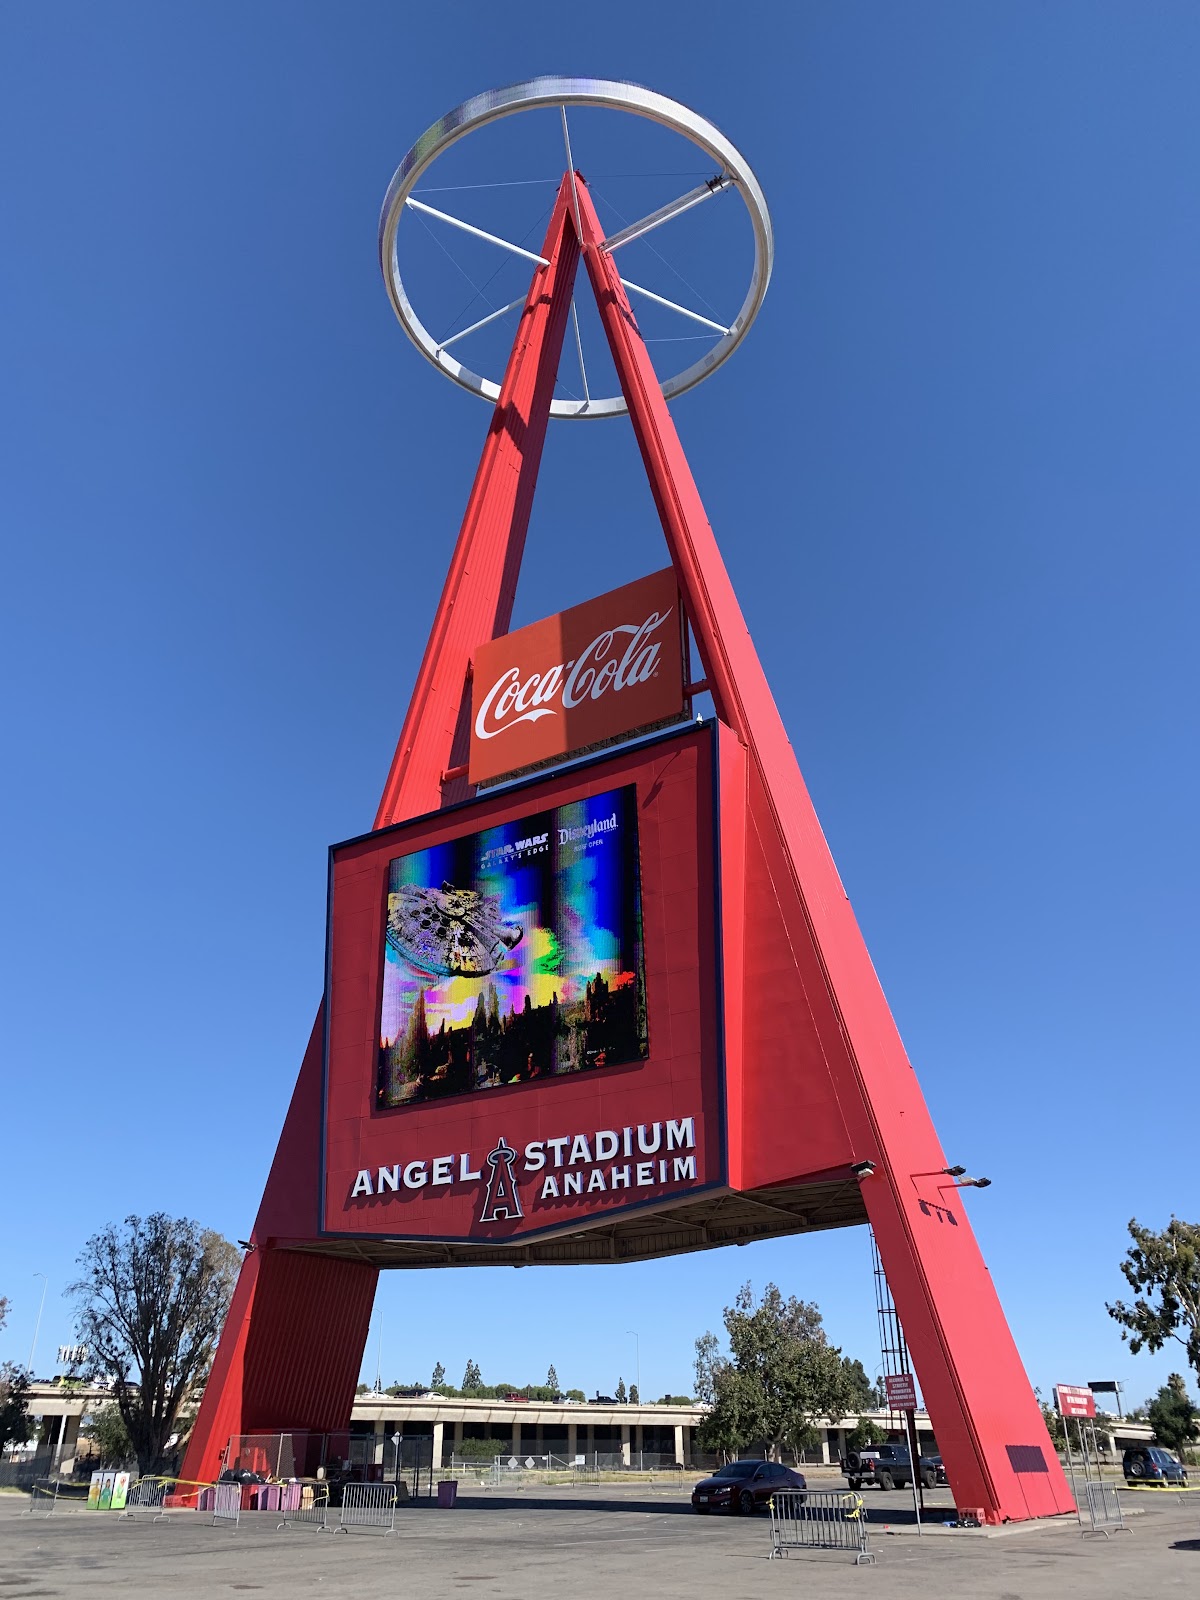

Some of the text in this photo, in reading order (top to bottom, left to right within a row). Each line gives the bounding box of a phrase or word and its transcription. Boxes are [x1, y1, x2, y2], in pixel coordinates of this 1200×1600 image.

[481, 832, 549, 862] STAR WARS
[527, 844, 549, 856] EDGE
[588, 838, 604, 848] OPEN
[351, 1152, 482, 1198] ANGEL
[523, 1116, 696, 1172] STADIUM
[540, 1155, 697, 1200] ANAHEIM
